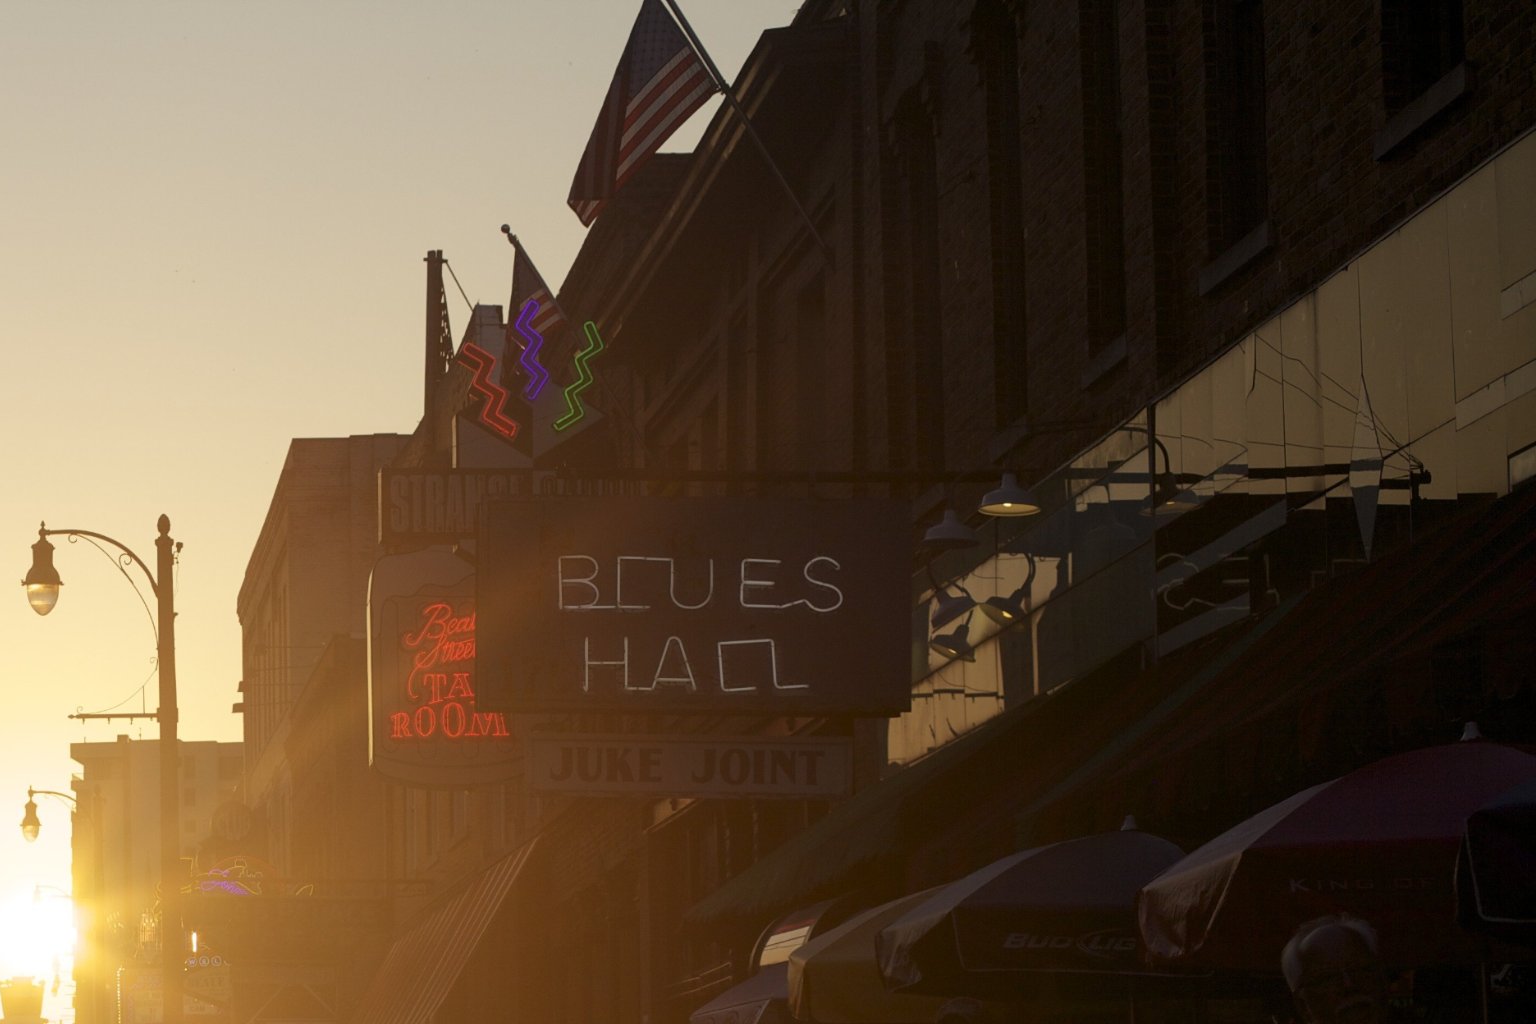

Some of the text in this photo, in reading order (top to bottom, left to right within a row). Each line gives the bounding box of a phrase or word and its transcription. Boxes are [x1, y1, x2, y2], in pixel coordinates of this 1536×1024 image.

[557, 554, 845, 613] BLUES
[582, 635, 811, 693] HALL
[391, 701, 510, 739] ROOM
[549, 746, 826, 787] JUKE JOINT
[1288, 877, 1375, 894] KING
